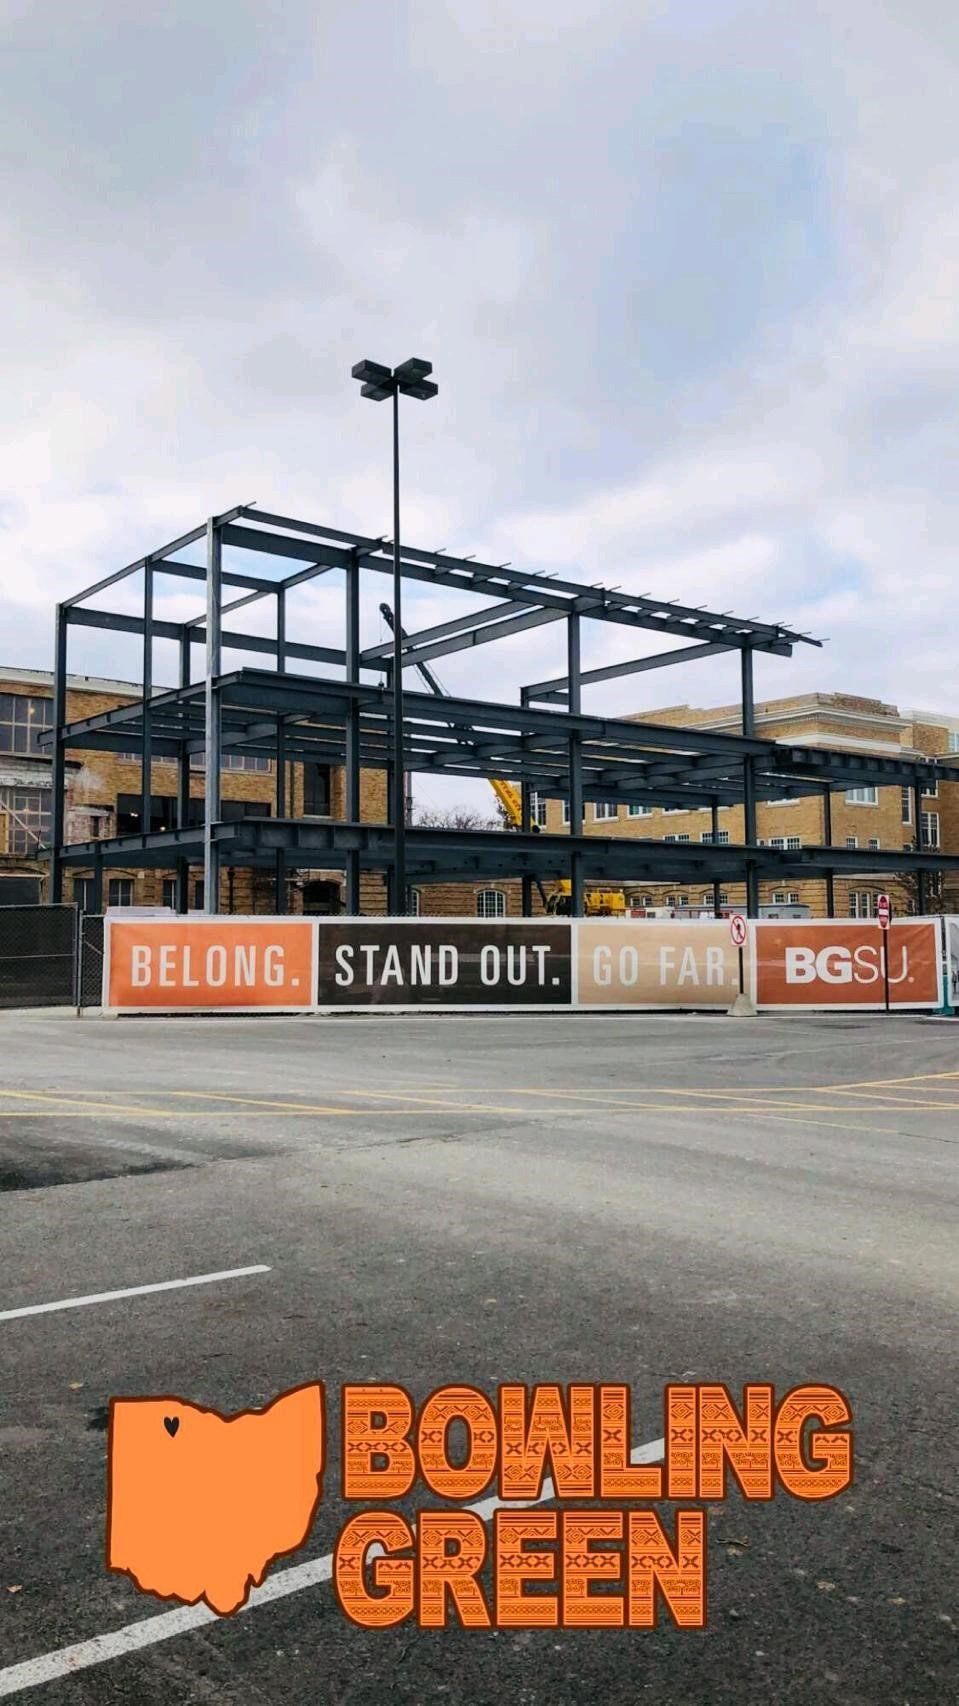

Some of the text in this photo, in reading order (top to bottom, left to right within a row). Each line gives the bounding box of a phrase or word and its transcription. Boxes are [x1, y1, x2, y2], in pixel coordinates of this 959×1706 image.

[131, 944, 300, 988] BELONG.
[334, 943, 561, 987] STAND OUT.
[592, 944, 740, 987] GO FAR.
[784, 944, 915, 985] BGSU.
